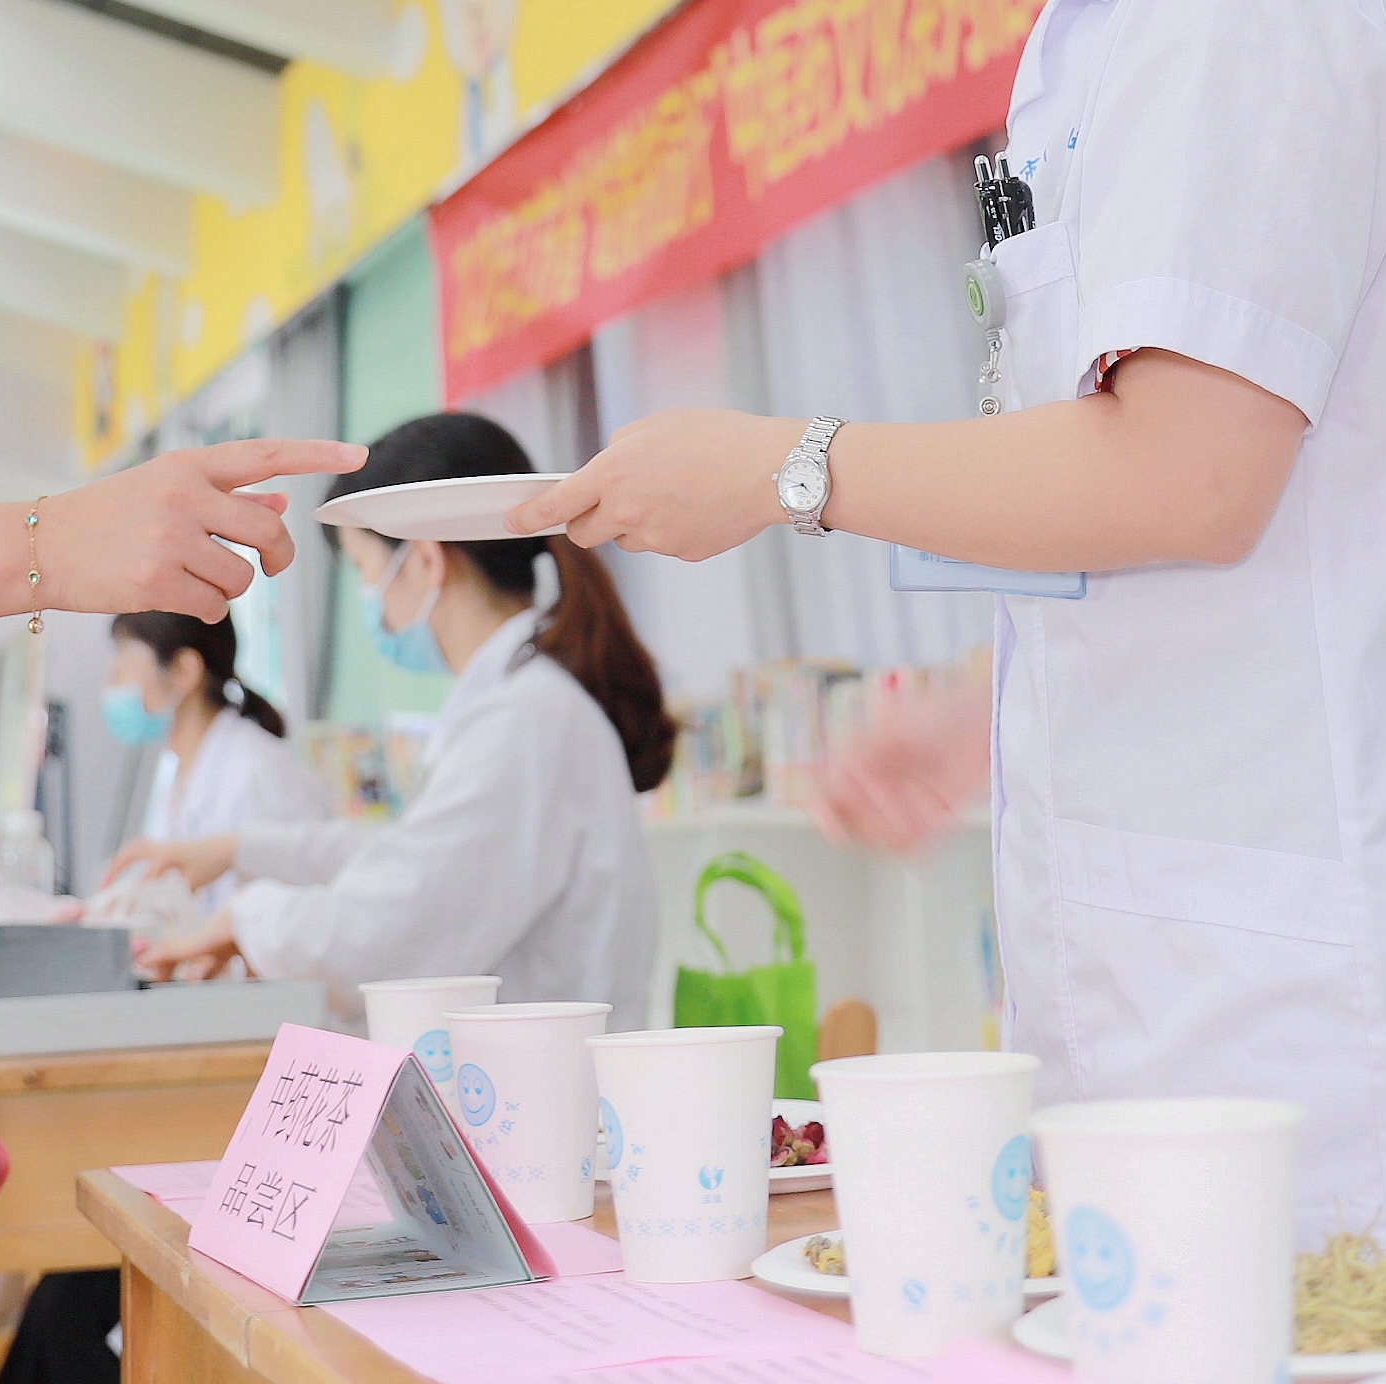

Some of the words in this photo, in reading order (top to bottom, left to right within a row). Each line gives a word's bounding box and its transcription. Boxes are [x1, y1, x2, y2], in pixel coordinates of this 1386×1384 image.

[261, 1058, 364, 1153] 中药花茶
[218, 1163, 318, 1242] 品尝区
